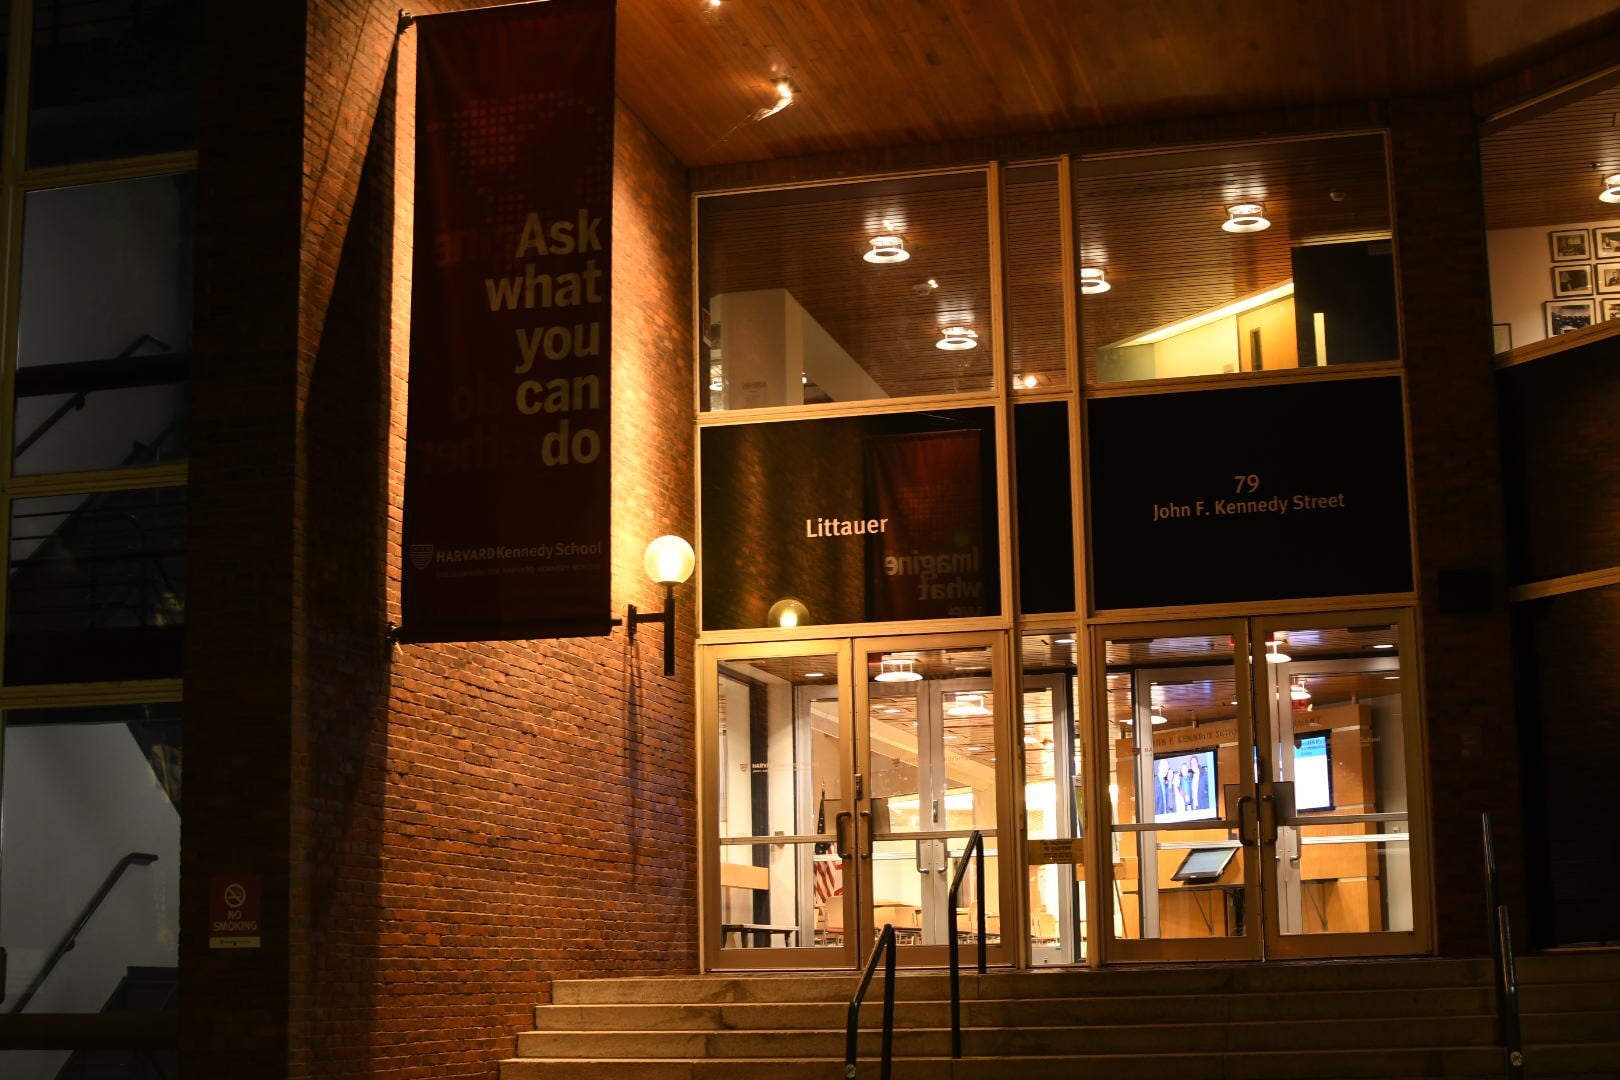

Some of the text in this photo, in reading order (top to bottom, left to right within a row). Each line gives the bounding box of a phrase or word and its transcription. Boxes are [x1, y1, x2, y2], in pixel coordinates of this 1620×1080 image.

[515, 208, 602, 258] Ask
[485, 259, 602, 312] what
[514, 322, 600, 374] you
[516, 374, 600, 415] can
[541, 419, 600, 466] do
[1234, 474, 1260, 493] 79
[1153, 493, 1345, 521] John F. Kennedy Street
[805, 517, 889, 539] Littauer
[436, 540, 602, 563] HARVARD Kennedy School
[213, 920, 257, 931] SMOKING
[227, 910, 243, 920] NO
